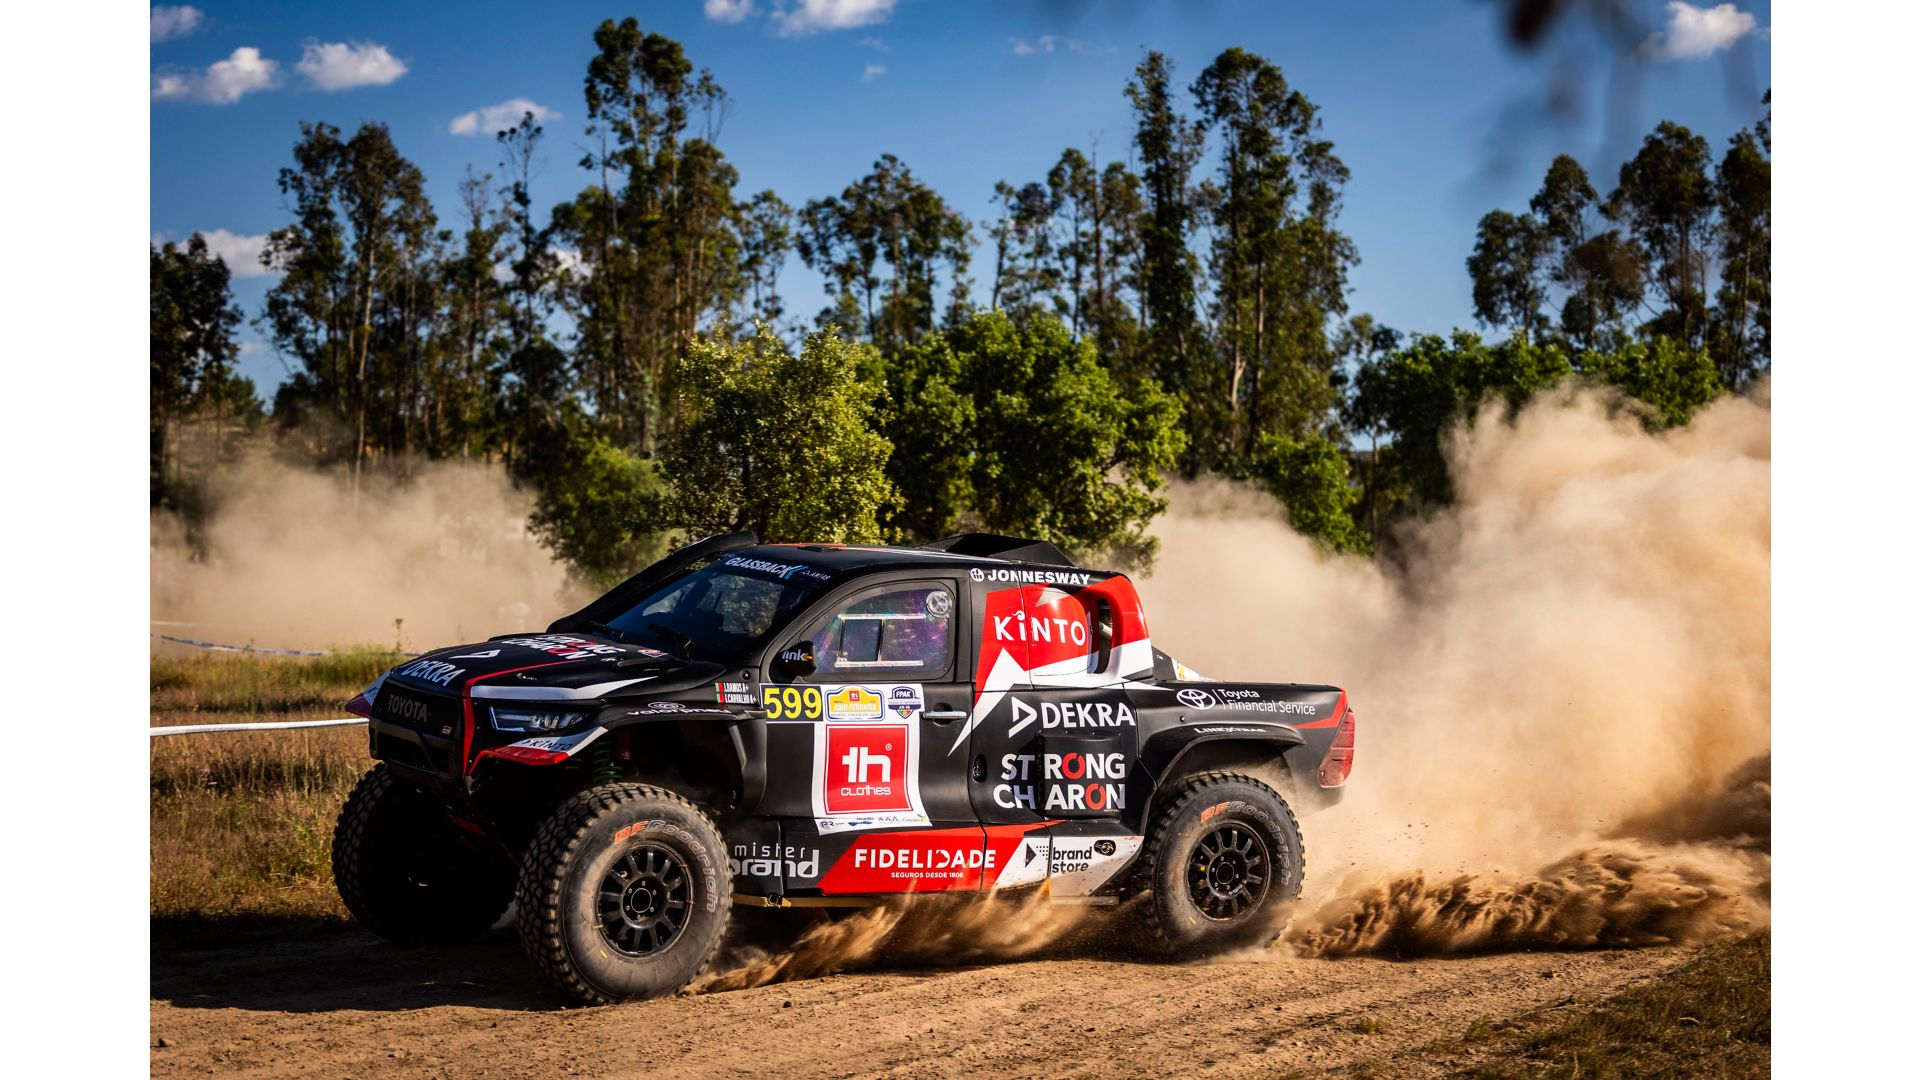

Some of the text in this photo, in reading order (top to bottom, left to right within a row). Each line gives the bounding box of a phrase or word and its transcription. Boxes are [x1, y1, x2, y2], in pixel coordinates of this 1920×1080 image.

[988, 569, 1091, 585] JONNESWAY
[400, 660, 466, 687] DEKRA
[1218, 689, 1260, 699] Toyota
[387, 694, 428, 722] TOYOTA
[763, 687, 822, 719] 599
[1228, 700, 1316, 715] Financial Service
[1041, 702, 1136, 728] DEKRA
[842, 746, 891, 782] th
[734, 842, 806, 858] mister
[855, 849, 996, 868] FIDELIDADE
[1052, 846, 1092, 860] brand
[1051, 862, 1089, 873] store
